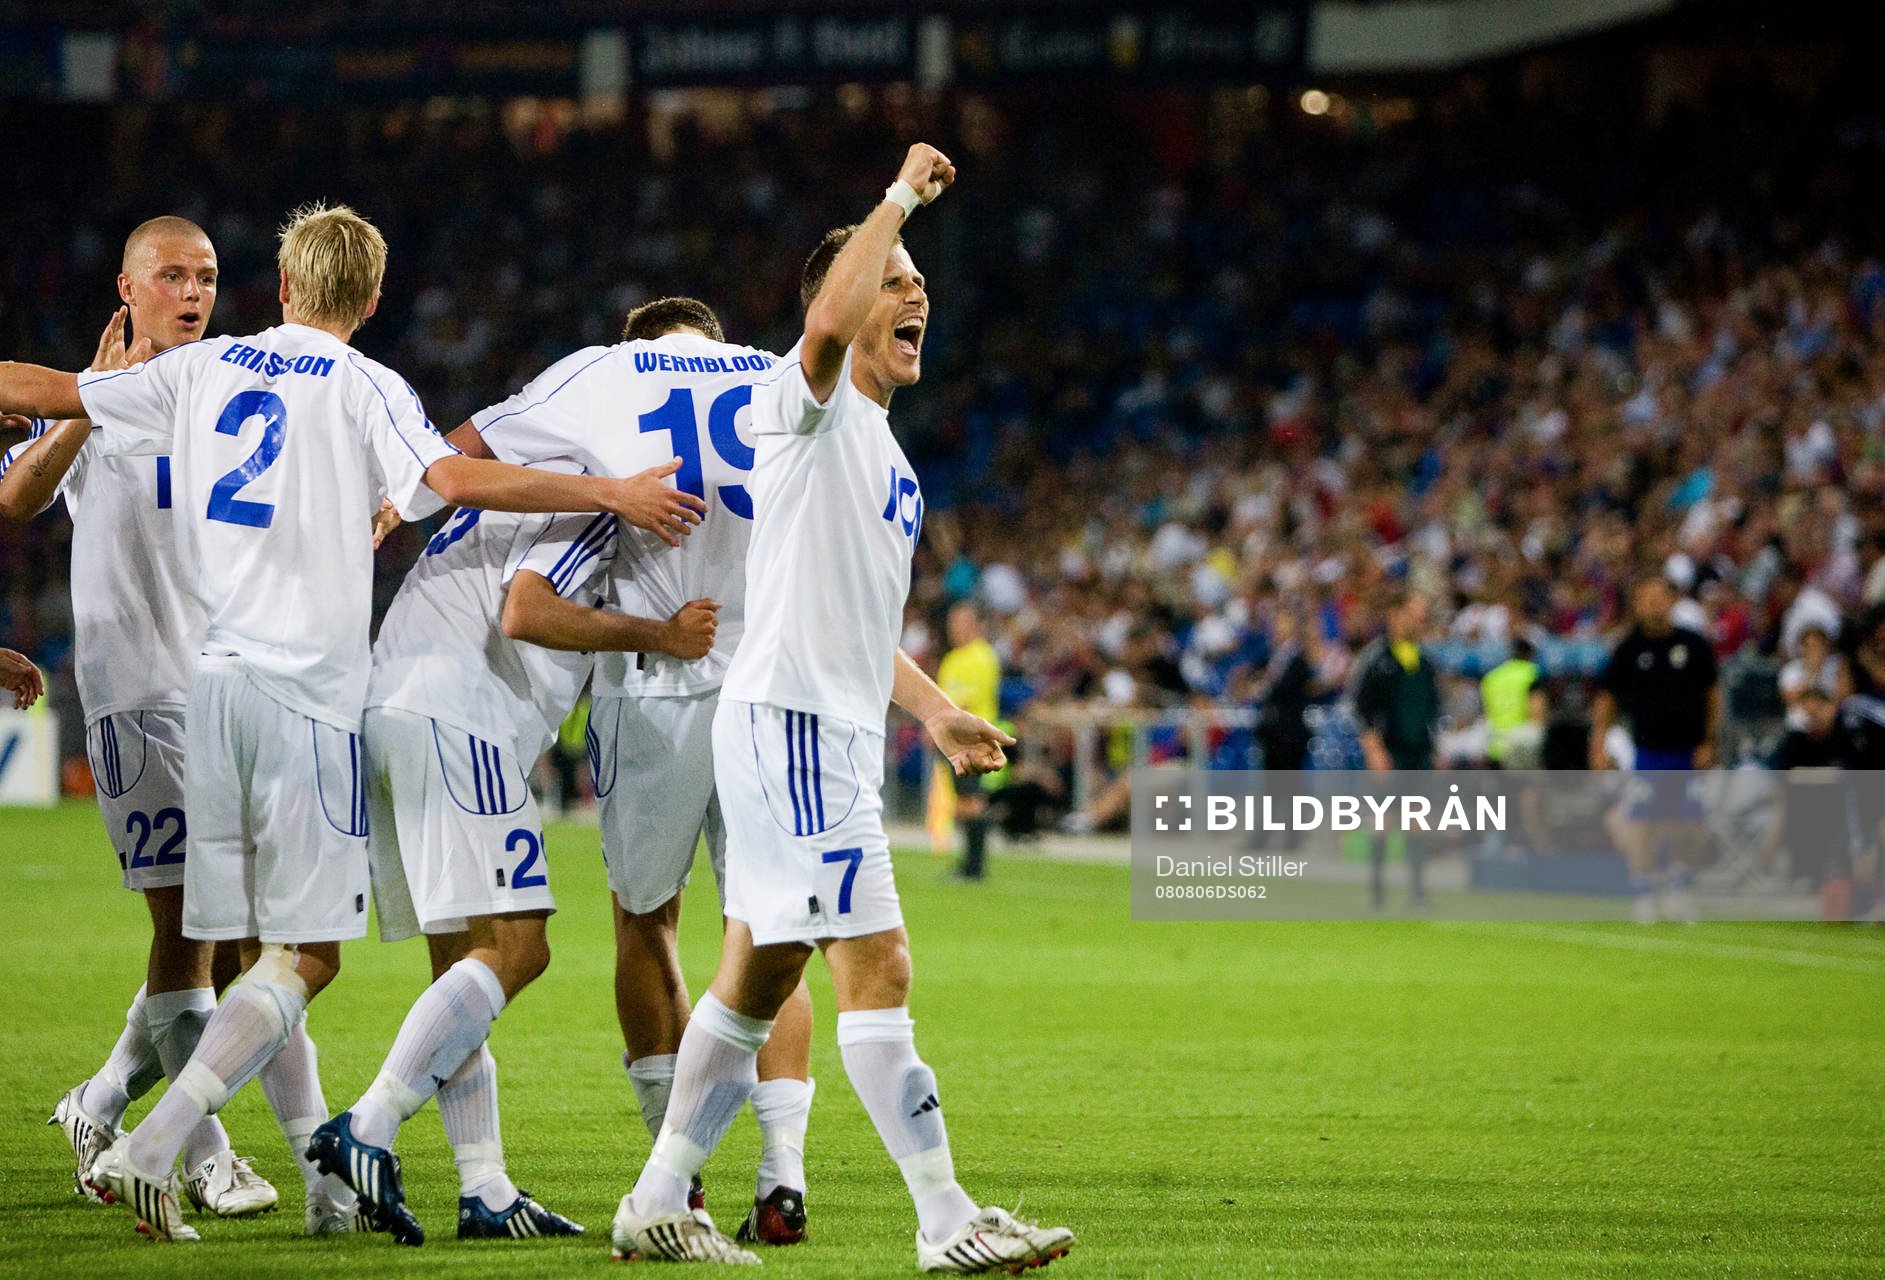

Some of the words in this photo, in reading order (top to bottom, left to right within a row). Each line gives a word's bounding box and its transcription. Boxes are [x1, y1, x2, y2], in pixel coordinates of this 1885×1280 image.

[207, 390, 287, 529] 2
[127, 807, 187, 869] 22
[505, 828, 548, 889] 2
[821, 847, 864, 914] 7
